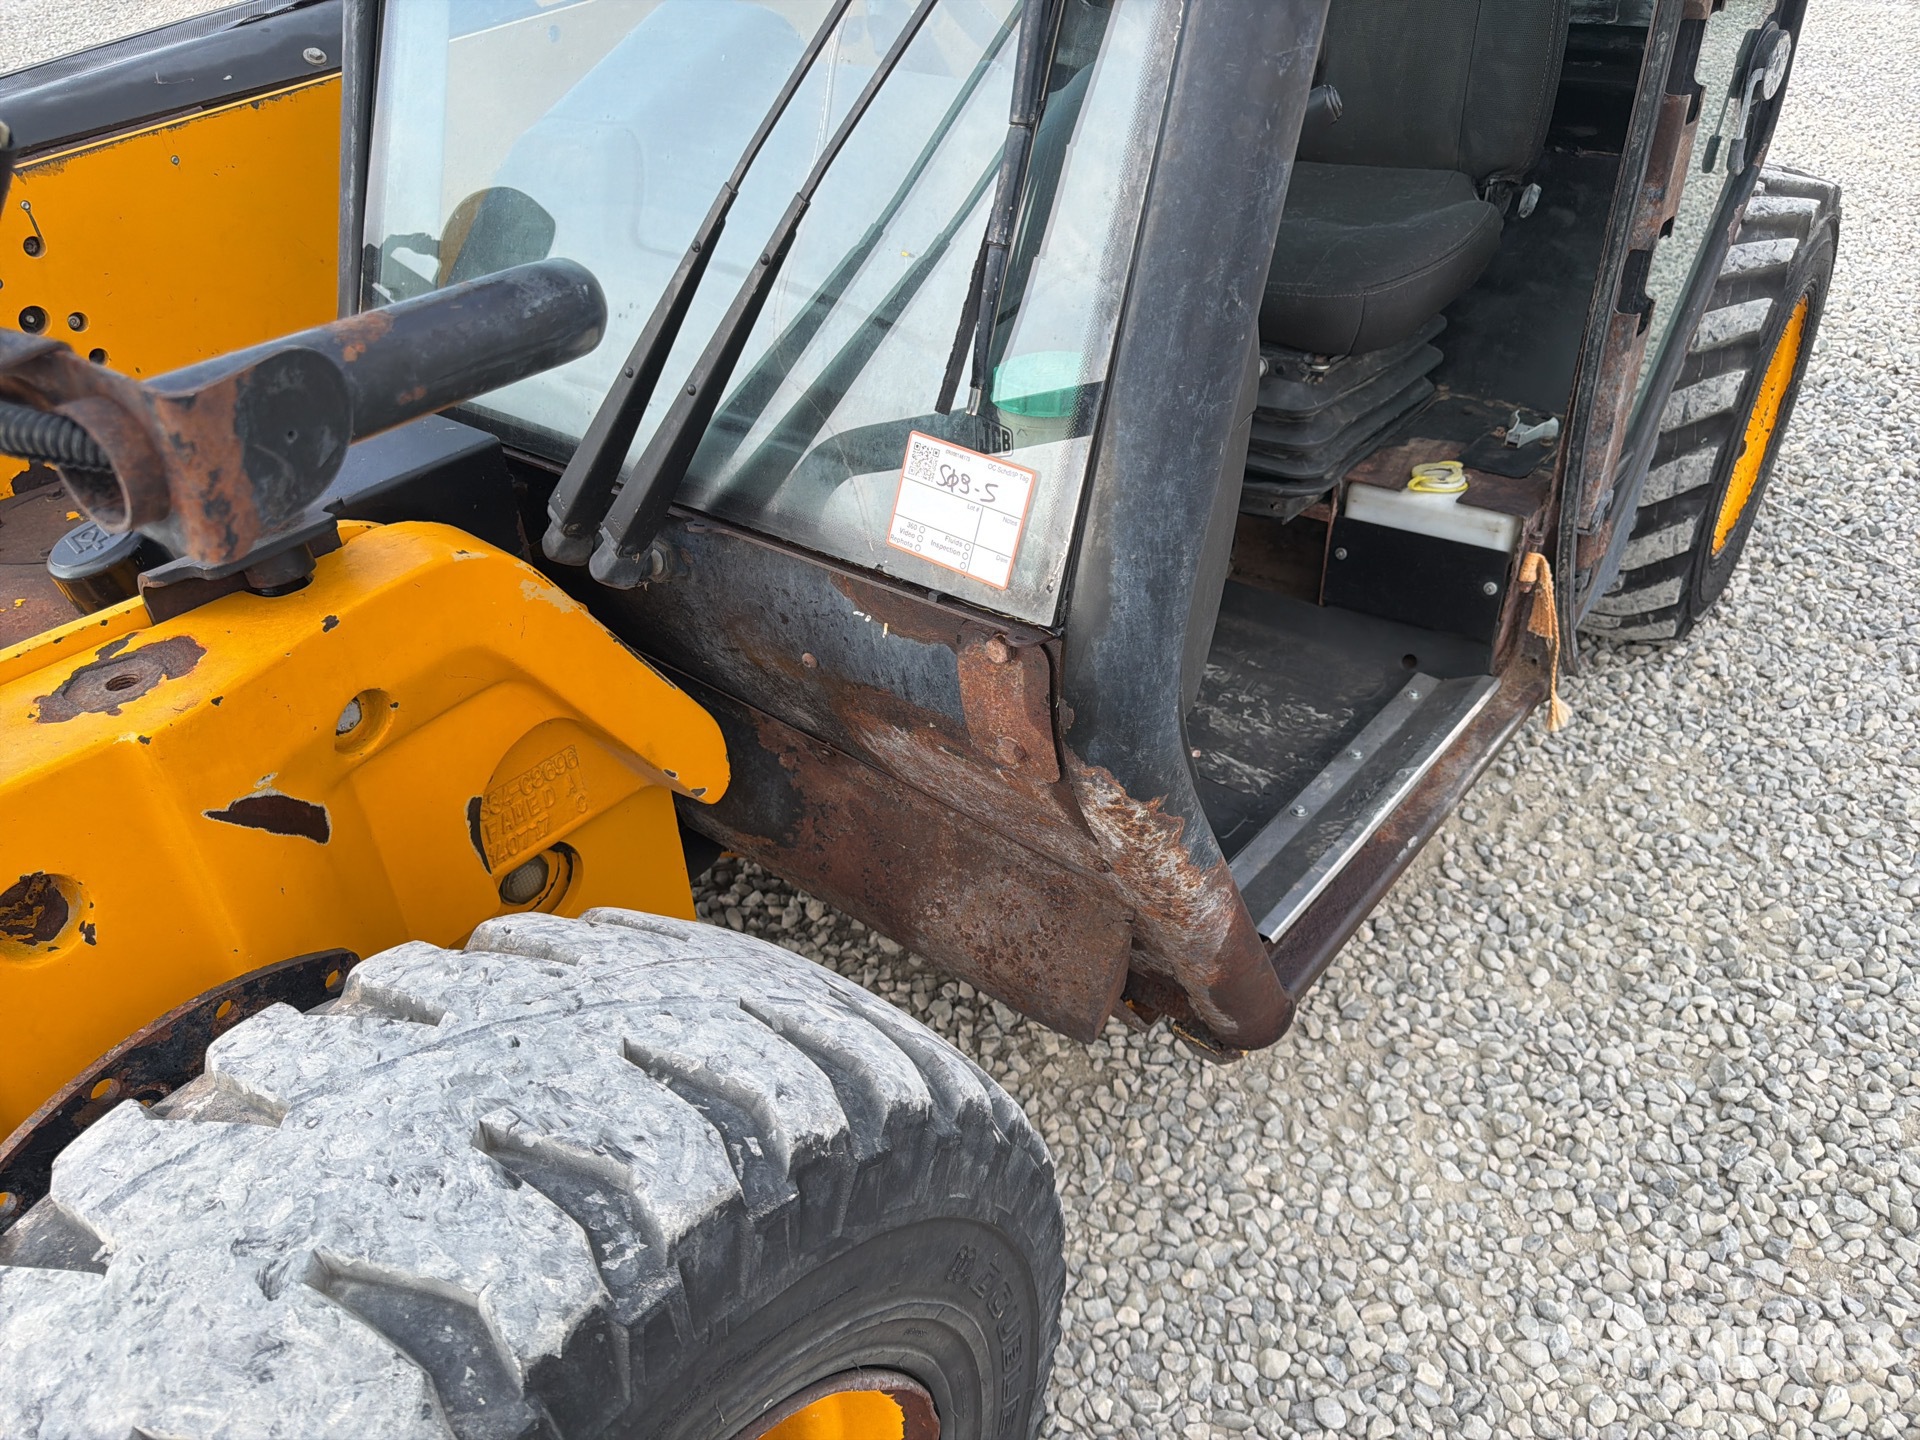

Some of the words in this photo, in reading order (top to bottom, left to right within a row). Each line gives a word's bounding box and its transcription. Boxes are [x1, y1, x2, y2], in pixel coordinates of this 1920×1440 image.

[979, 421, 1011, 454] JCB
[1019, 472, 1030, 484] Tag
[966, 503, 975, 511] Lot
[906, 521, 918, 531] 360
[1002, 516, 1018, 527] Notes
[899, 527, 916, 539] Video
[890, 533, 914, 548] Rephoto
[944, 535, 963, 548] Fluids
[930, 539, 961, 556] Inspection
